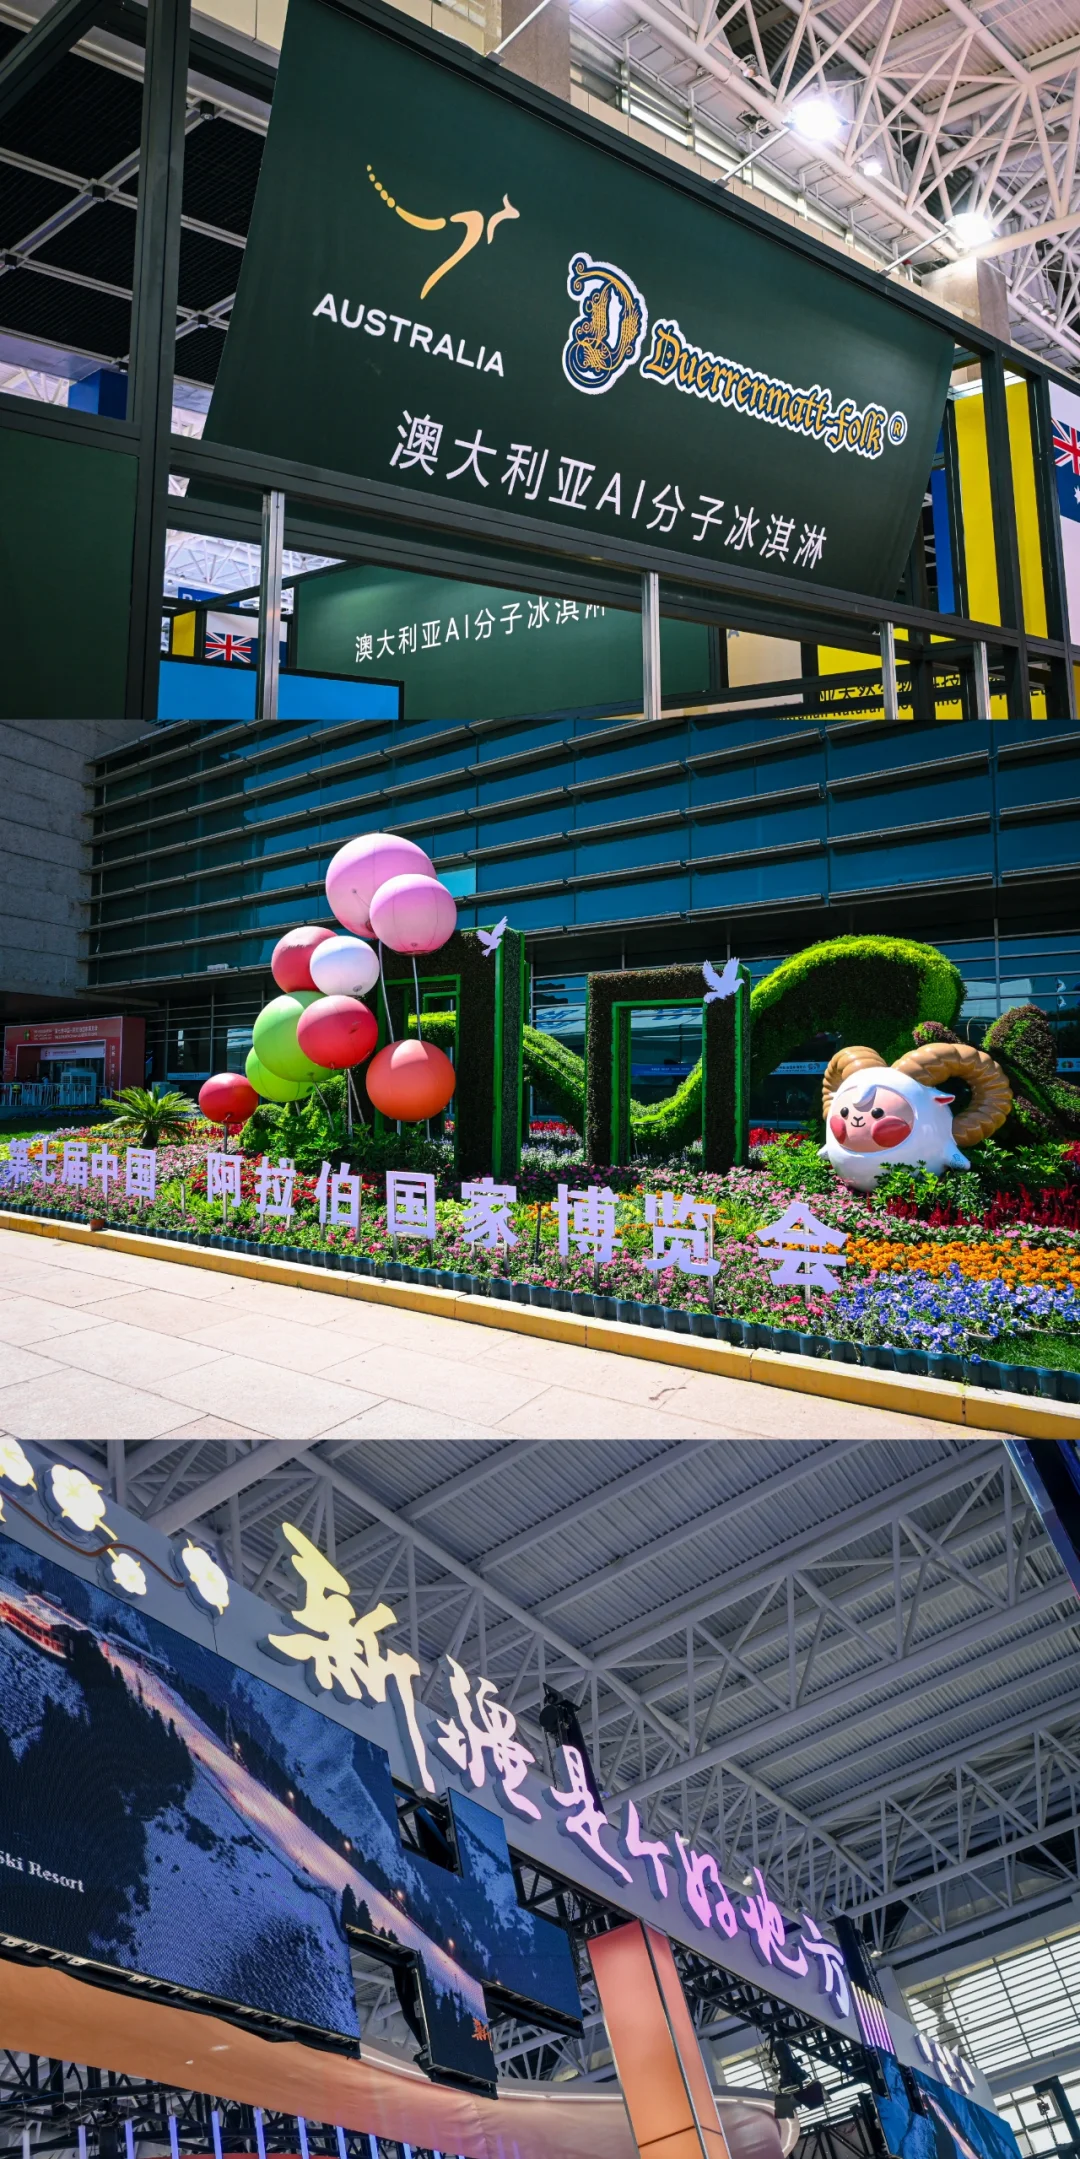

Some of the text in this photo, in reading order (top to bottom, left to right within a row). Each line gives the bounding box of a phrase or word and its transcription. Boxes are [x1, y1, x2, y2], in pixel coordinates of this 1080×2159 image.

[313, 293, 505, 377] AUSTRALIA
[389, 410, 827, 569] 澳大利亚AI分子冰淇淋
[206, 1152, 847, 1292] 阿拉伯国家博览会
[268, 1523, 849, 2017] 新疆是个好地方
[0, 1850, 84, 1893] Ski Resort
